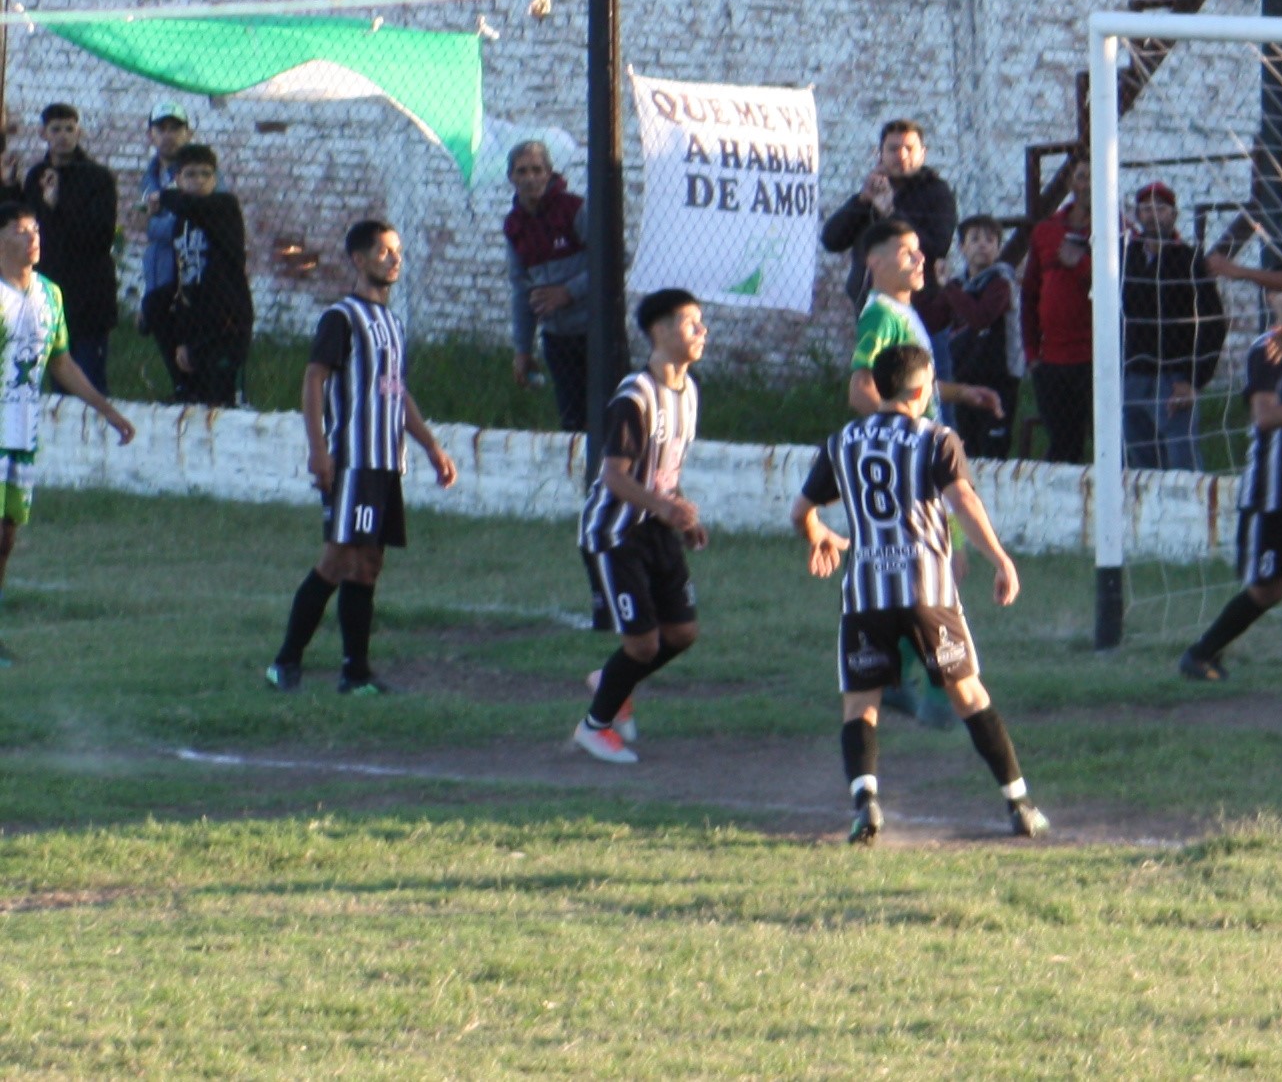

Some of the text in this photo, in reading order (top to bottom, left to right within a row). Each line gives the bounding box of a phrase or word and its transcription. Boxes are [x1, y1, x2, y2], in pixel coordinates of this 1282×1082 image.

[651, 89, 731, 126] QUE
[731, 99, 776, 131] ME
[684, 132, 711, 166] A
[685, 173, 741, 213] DE
[857, 451, 900, 527] 8
[354, 503, 374, 534] 10
[617, 591, 635, 622] 9
